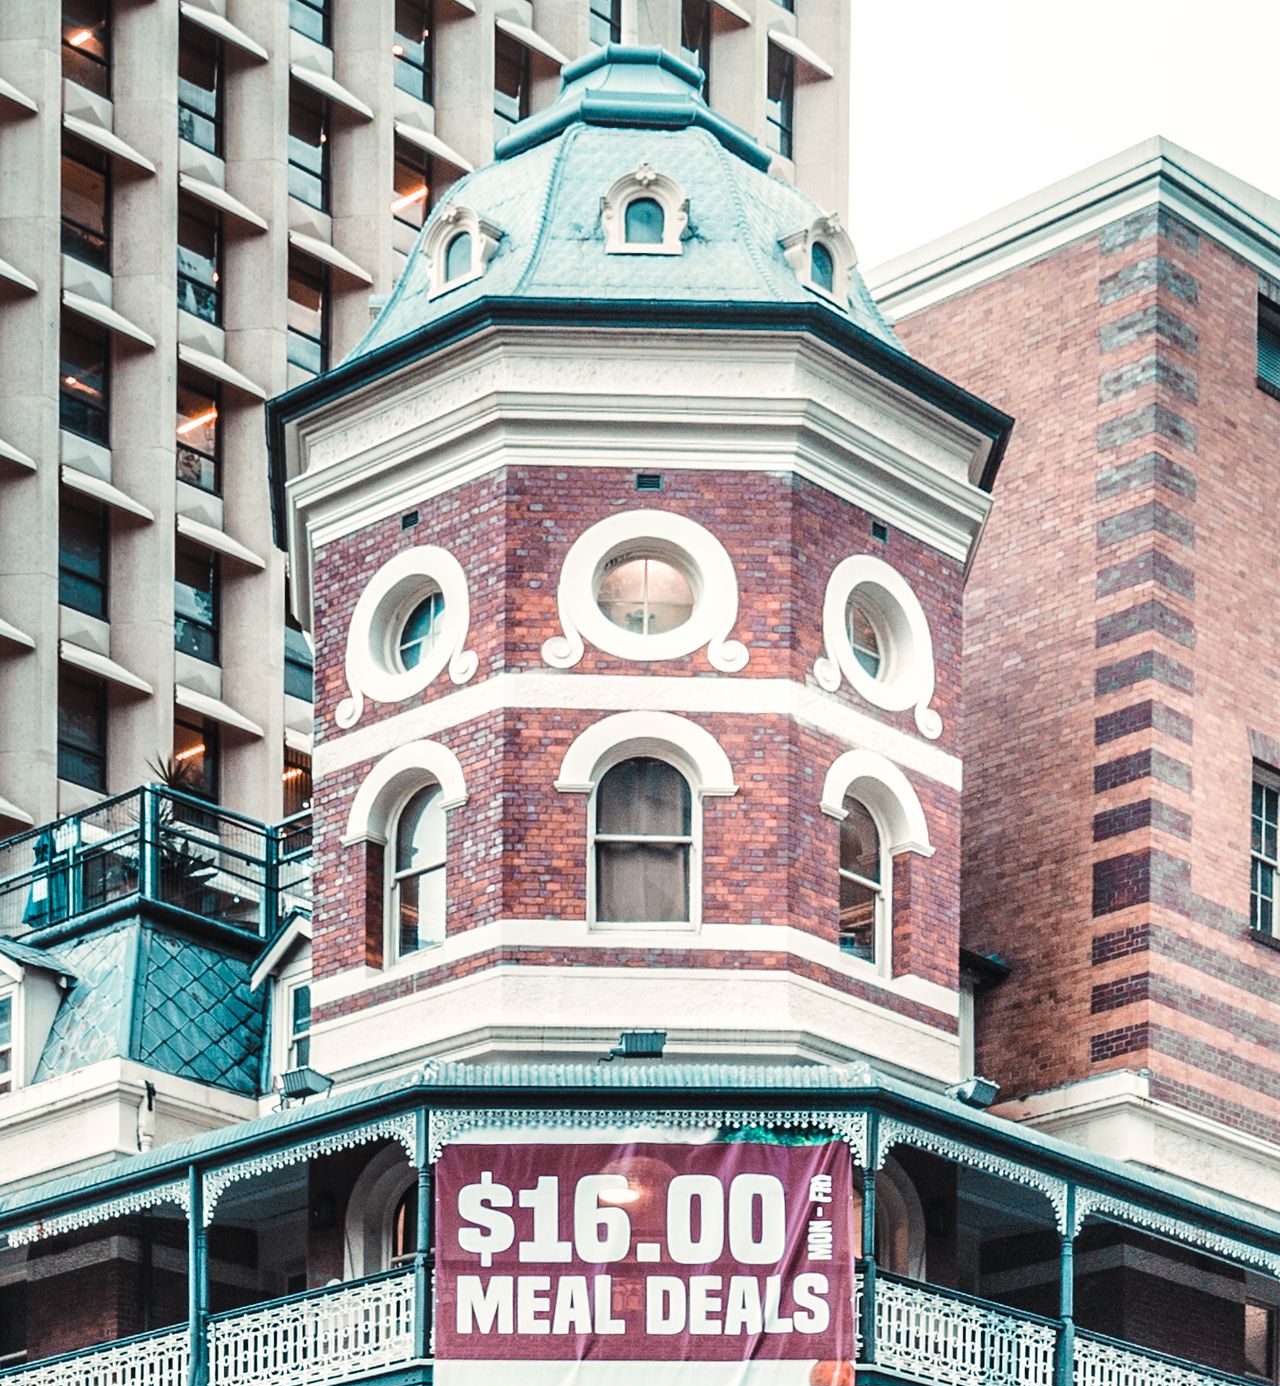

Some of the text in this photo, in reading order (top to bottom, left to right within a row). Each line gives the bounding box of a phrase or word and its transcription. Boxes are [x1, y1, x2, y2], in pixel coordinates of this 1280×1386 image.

[809, 1174, 832, 1203] FRI
[457, 1171, 786, 1268] $16.00
[807, 1221, 832, 1260] MON
[456, 1272, 830, 1336] MEAL DEALS
